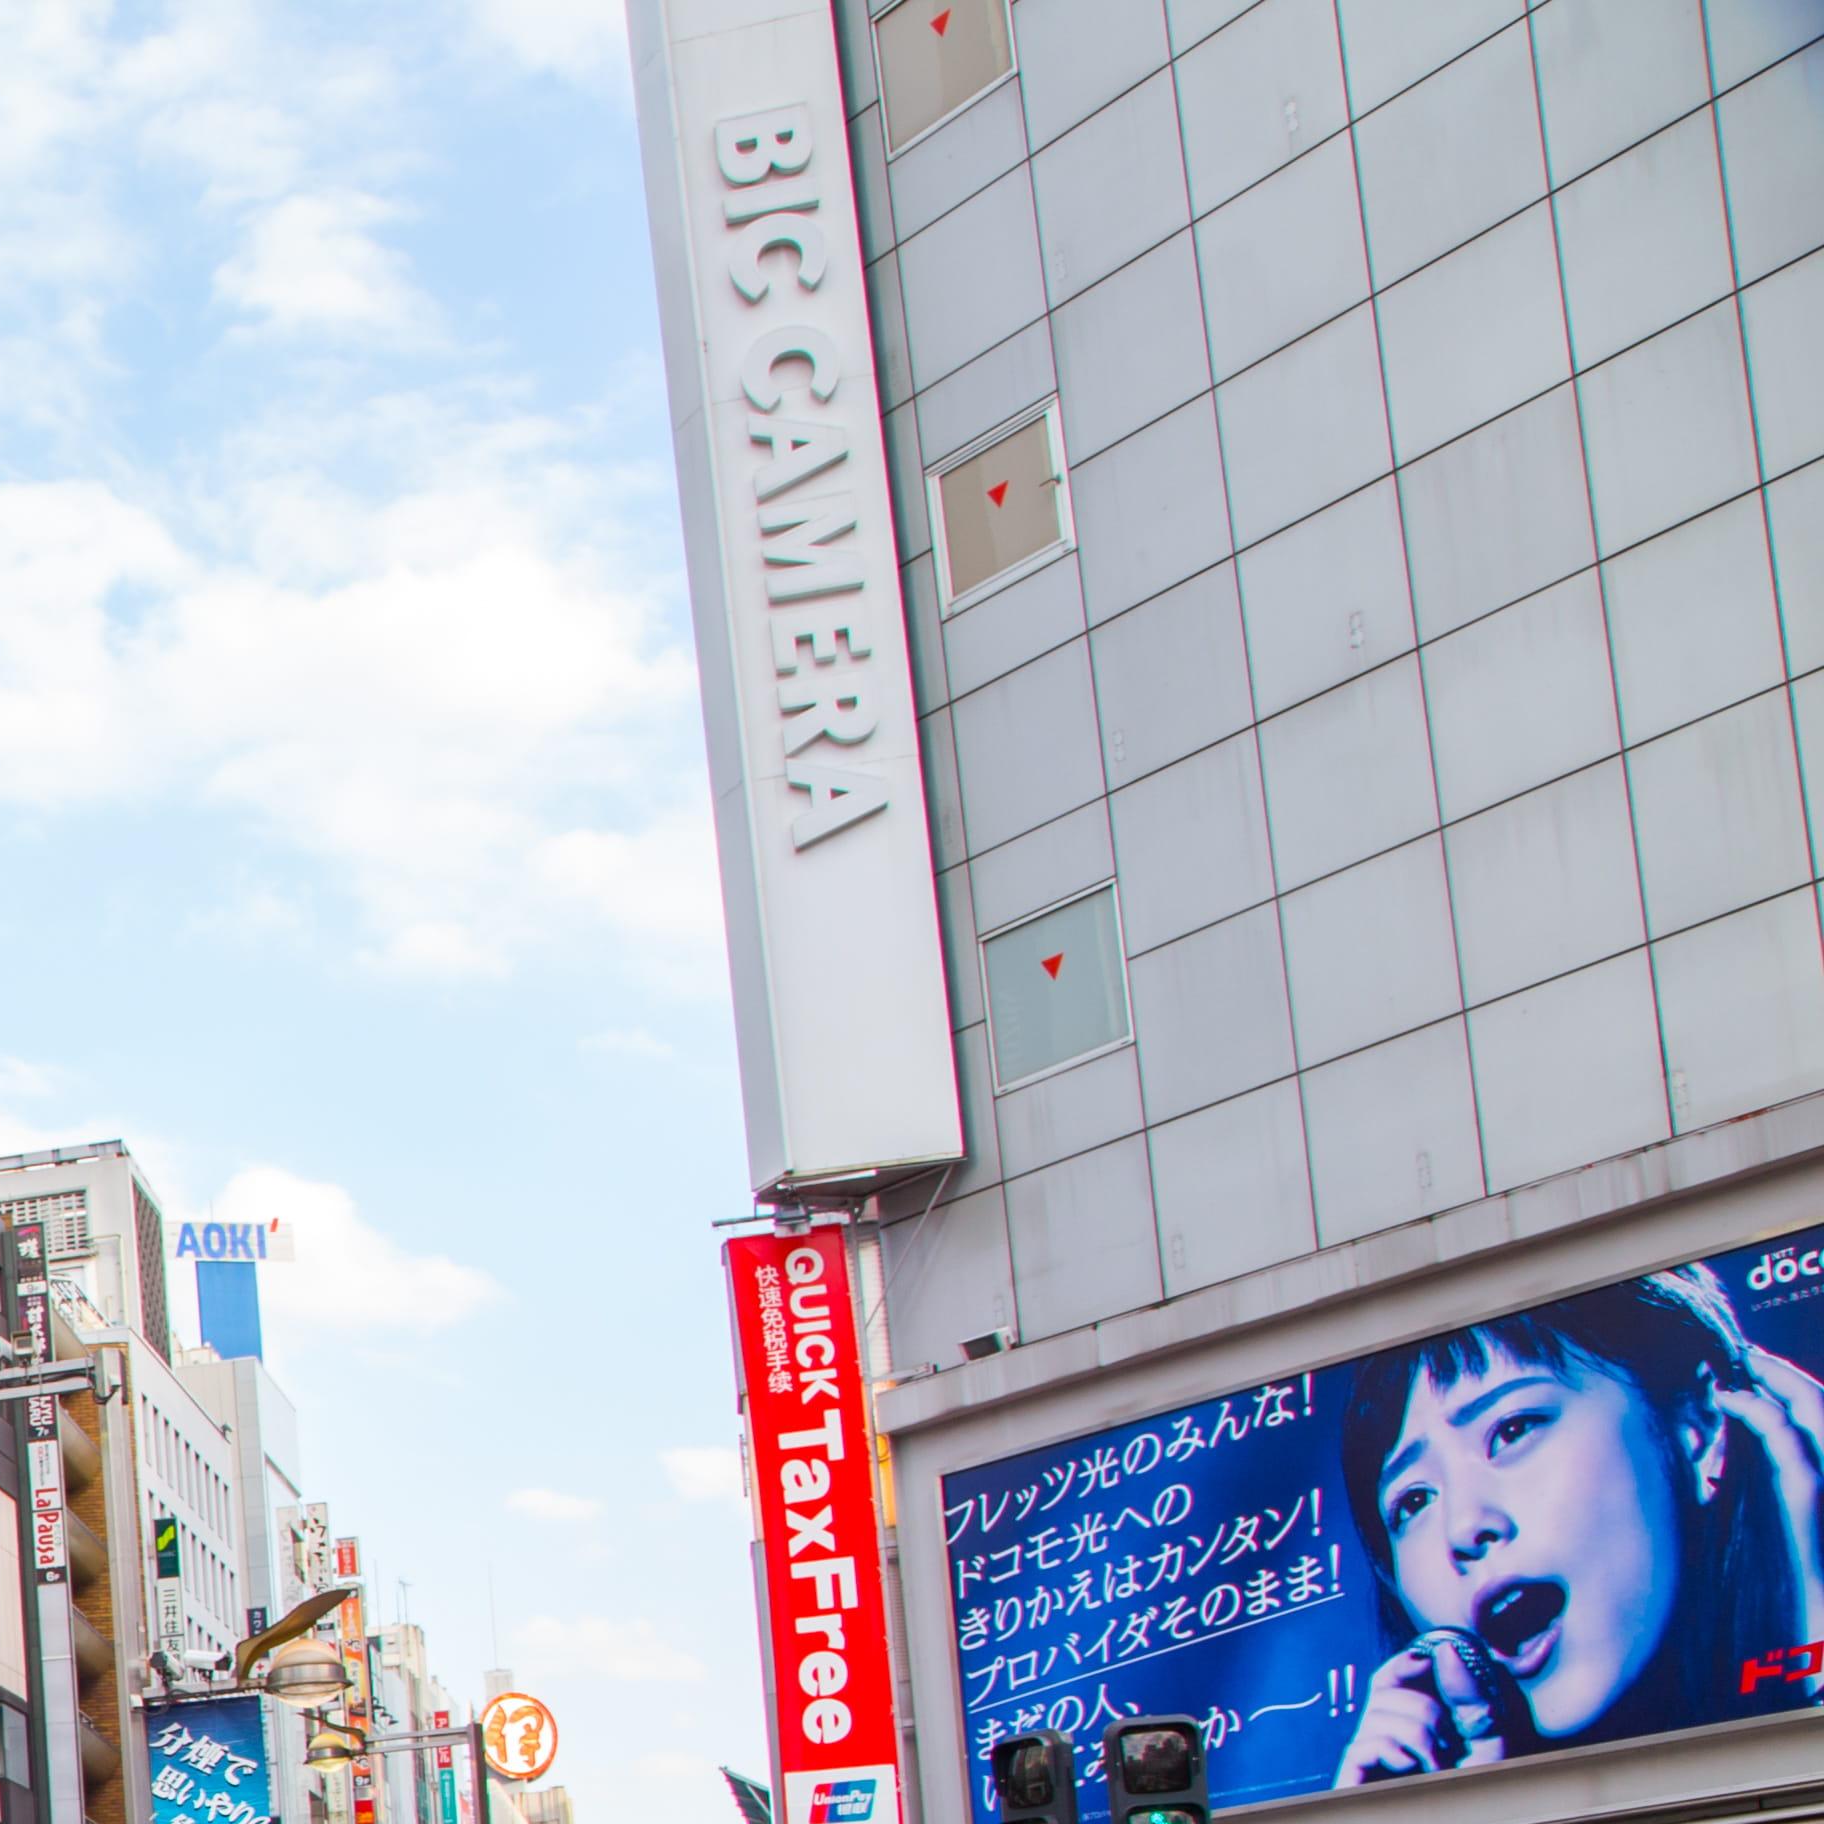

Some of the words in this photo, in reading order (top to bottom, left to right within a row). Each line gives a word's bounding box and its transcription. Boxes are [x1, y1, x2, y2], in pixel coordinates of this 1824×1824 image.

[712, 102, 829, 307] BIC
[739, 325, 890, 856] CAMERA
[176, 1222, 267, 1260] AOKI
[784, 1245, 841, 1406] QUICK
[35, 1487, 59, 1566] LaPausa
[777, 1408, 859, 1747] TaxFree
[956, 1483, 1193, 1600] ドコモ光への
[150, 1722, 259, 1786] 分煙で
